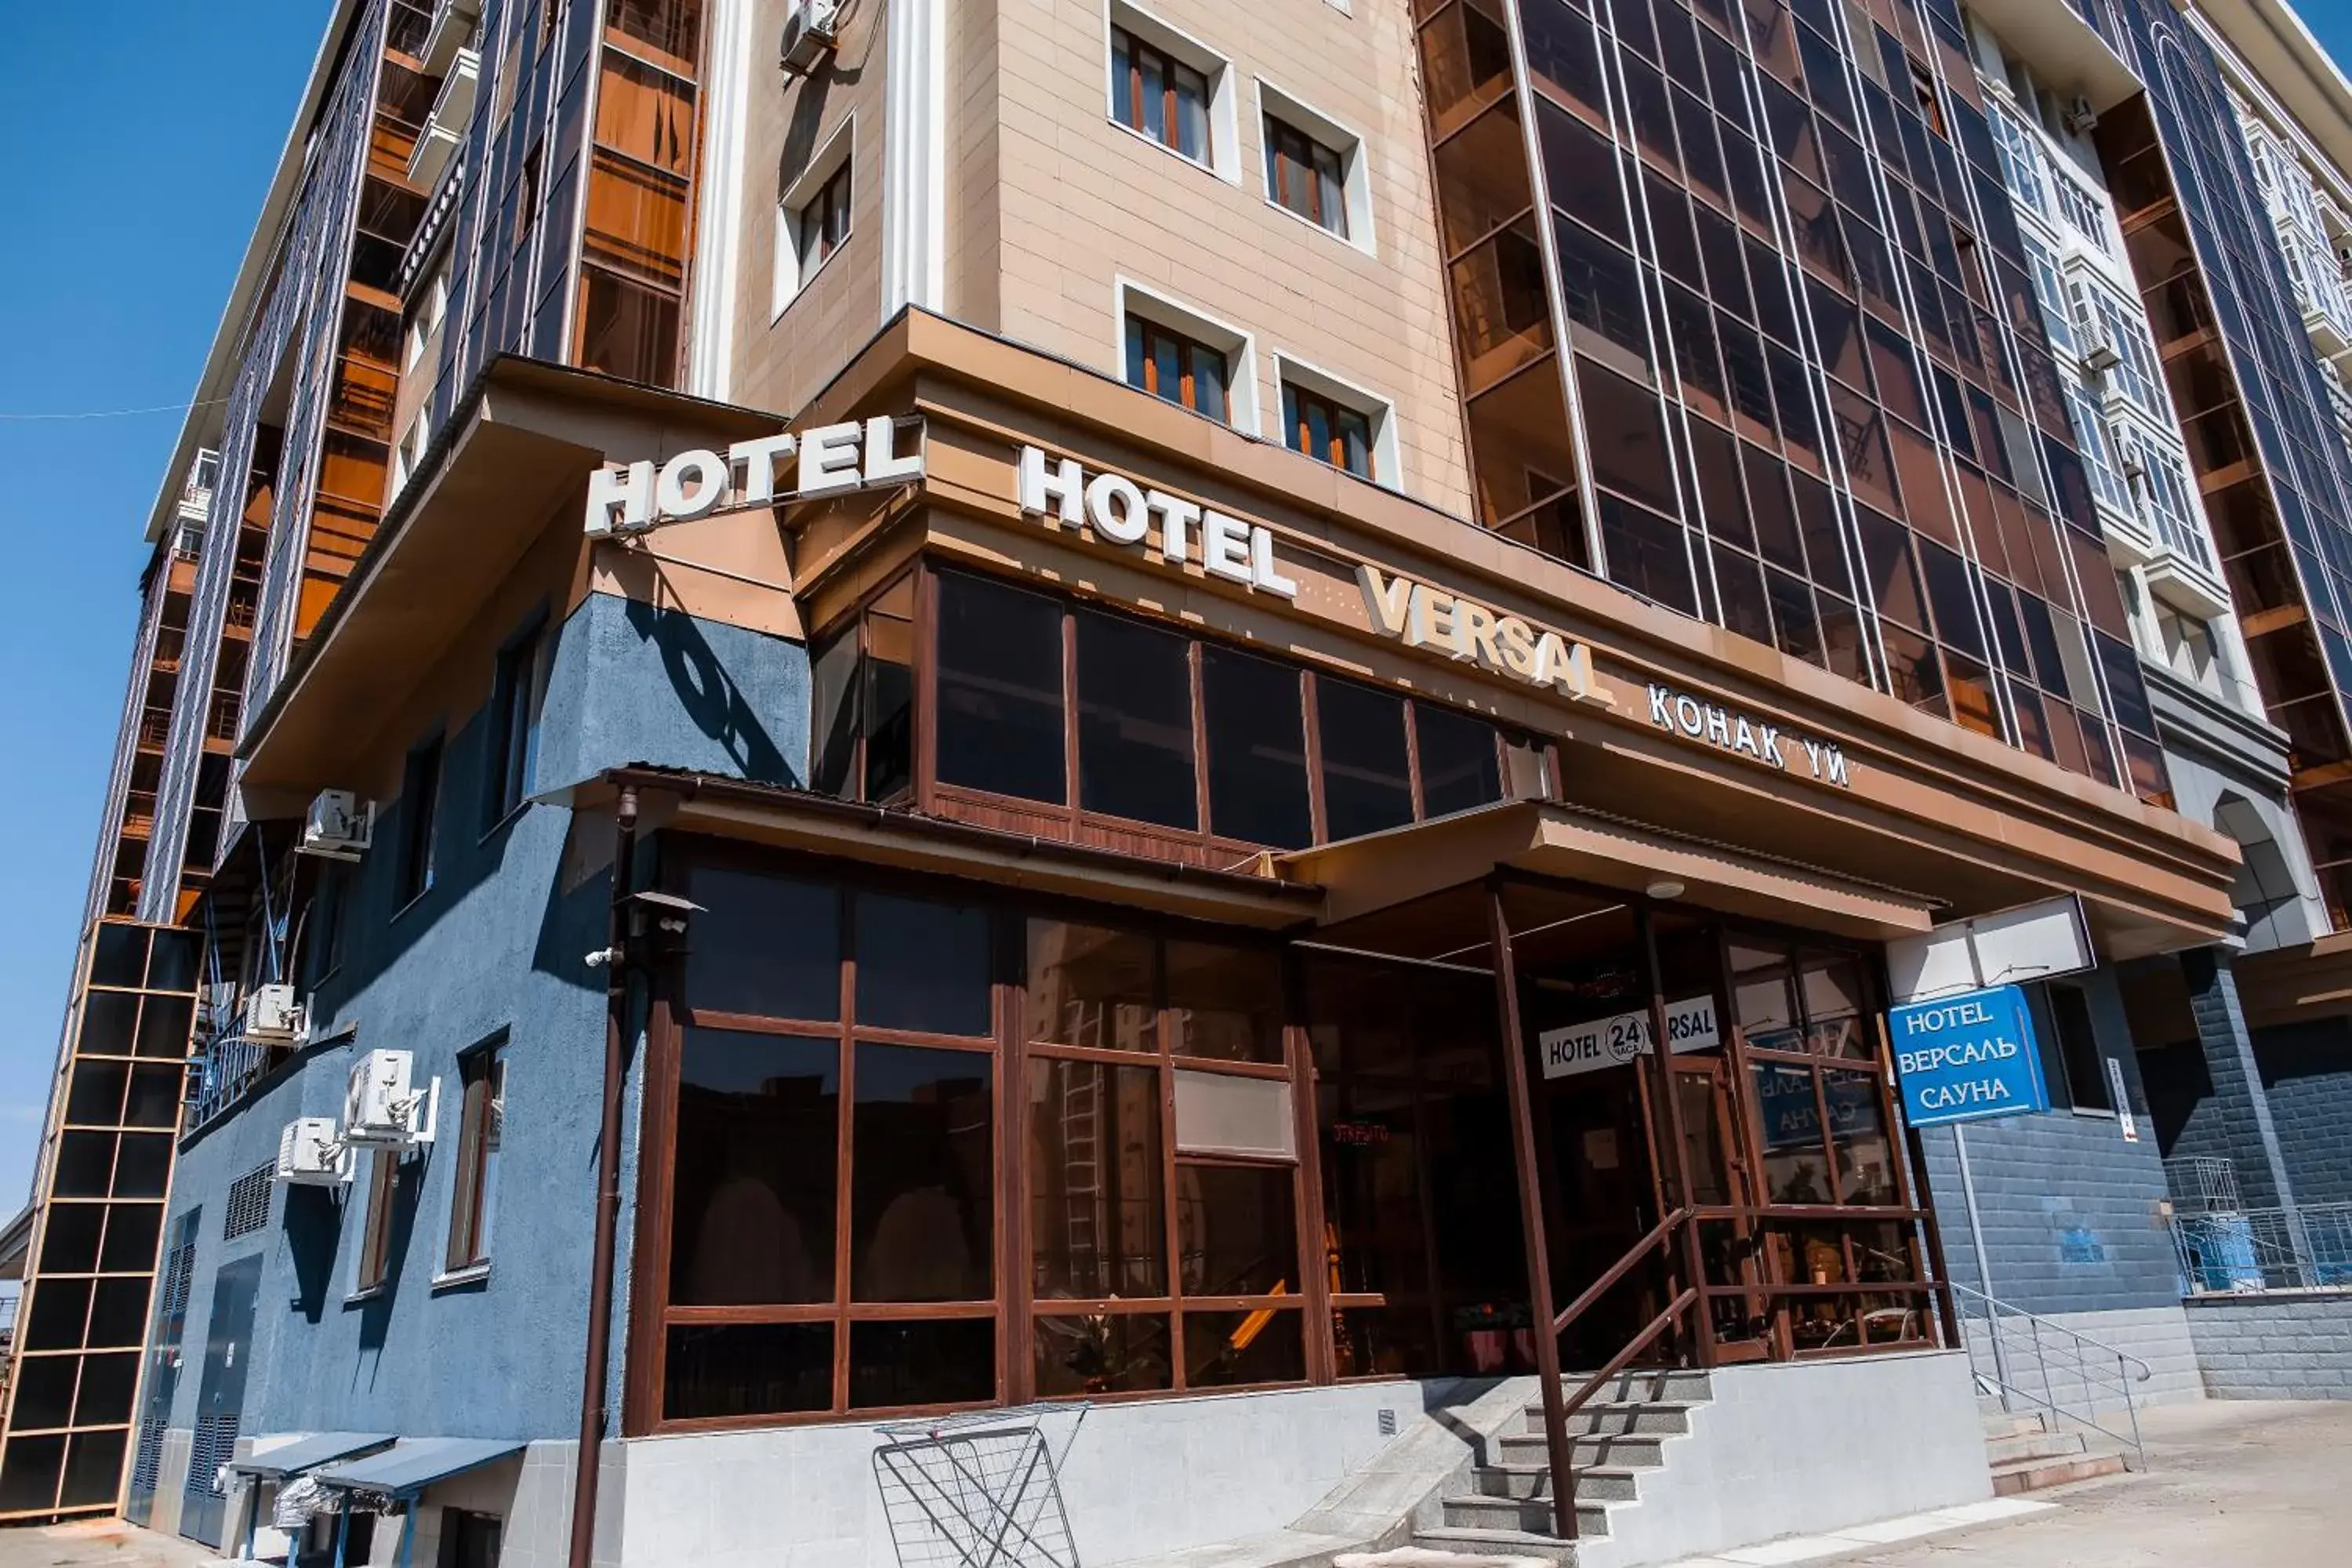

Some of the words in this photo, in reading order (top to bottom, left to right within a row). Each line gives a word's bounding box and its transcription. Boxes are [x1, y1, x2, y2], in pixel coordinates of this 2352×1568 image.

[584, 415, 925, 538] HOTEL
[1019, 444, 1297, 599] HOTEL
[1356, 564, 1617, 706] VERSAL
[1549, 1033, 1601, 1065] HOTEL
[1611, 1022, 1641, 1047] 24
[1646, 1009, 1714, 1042] RSAL
[1906, 1001, 1994, 1035] HOTEL
[1899, 1037, 2017, 1075] ВЕРСАЛЬ
[1921, 1078, 2011, 1109] САУНА
